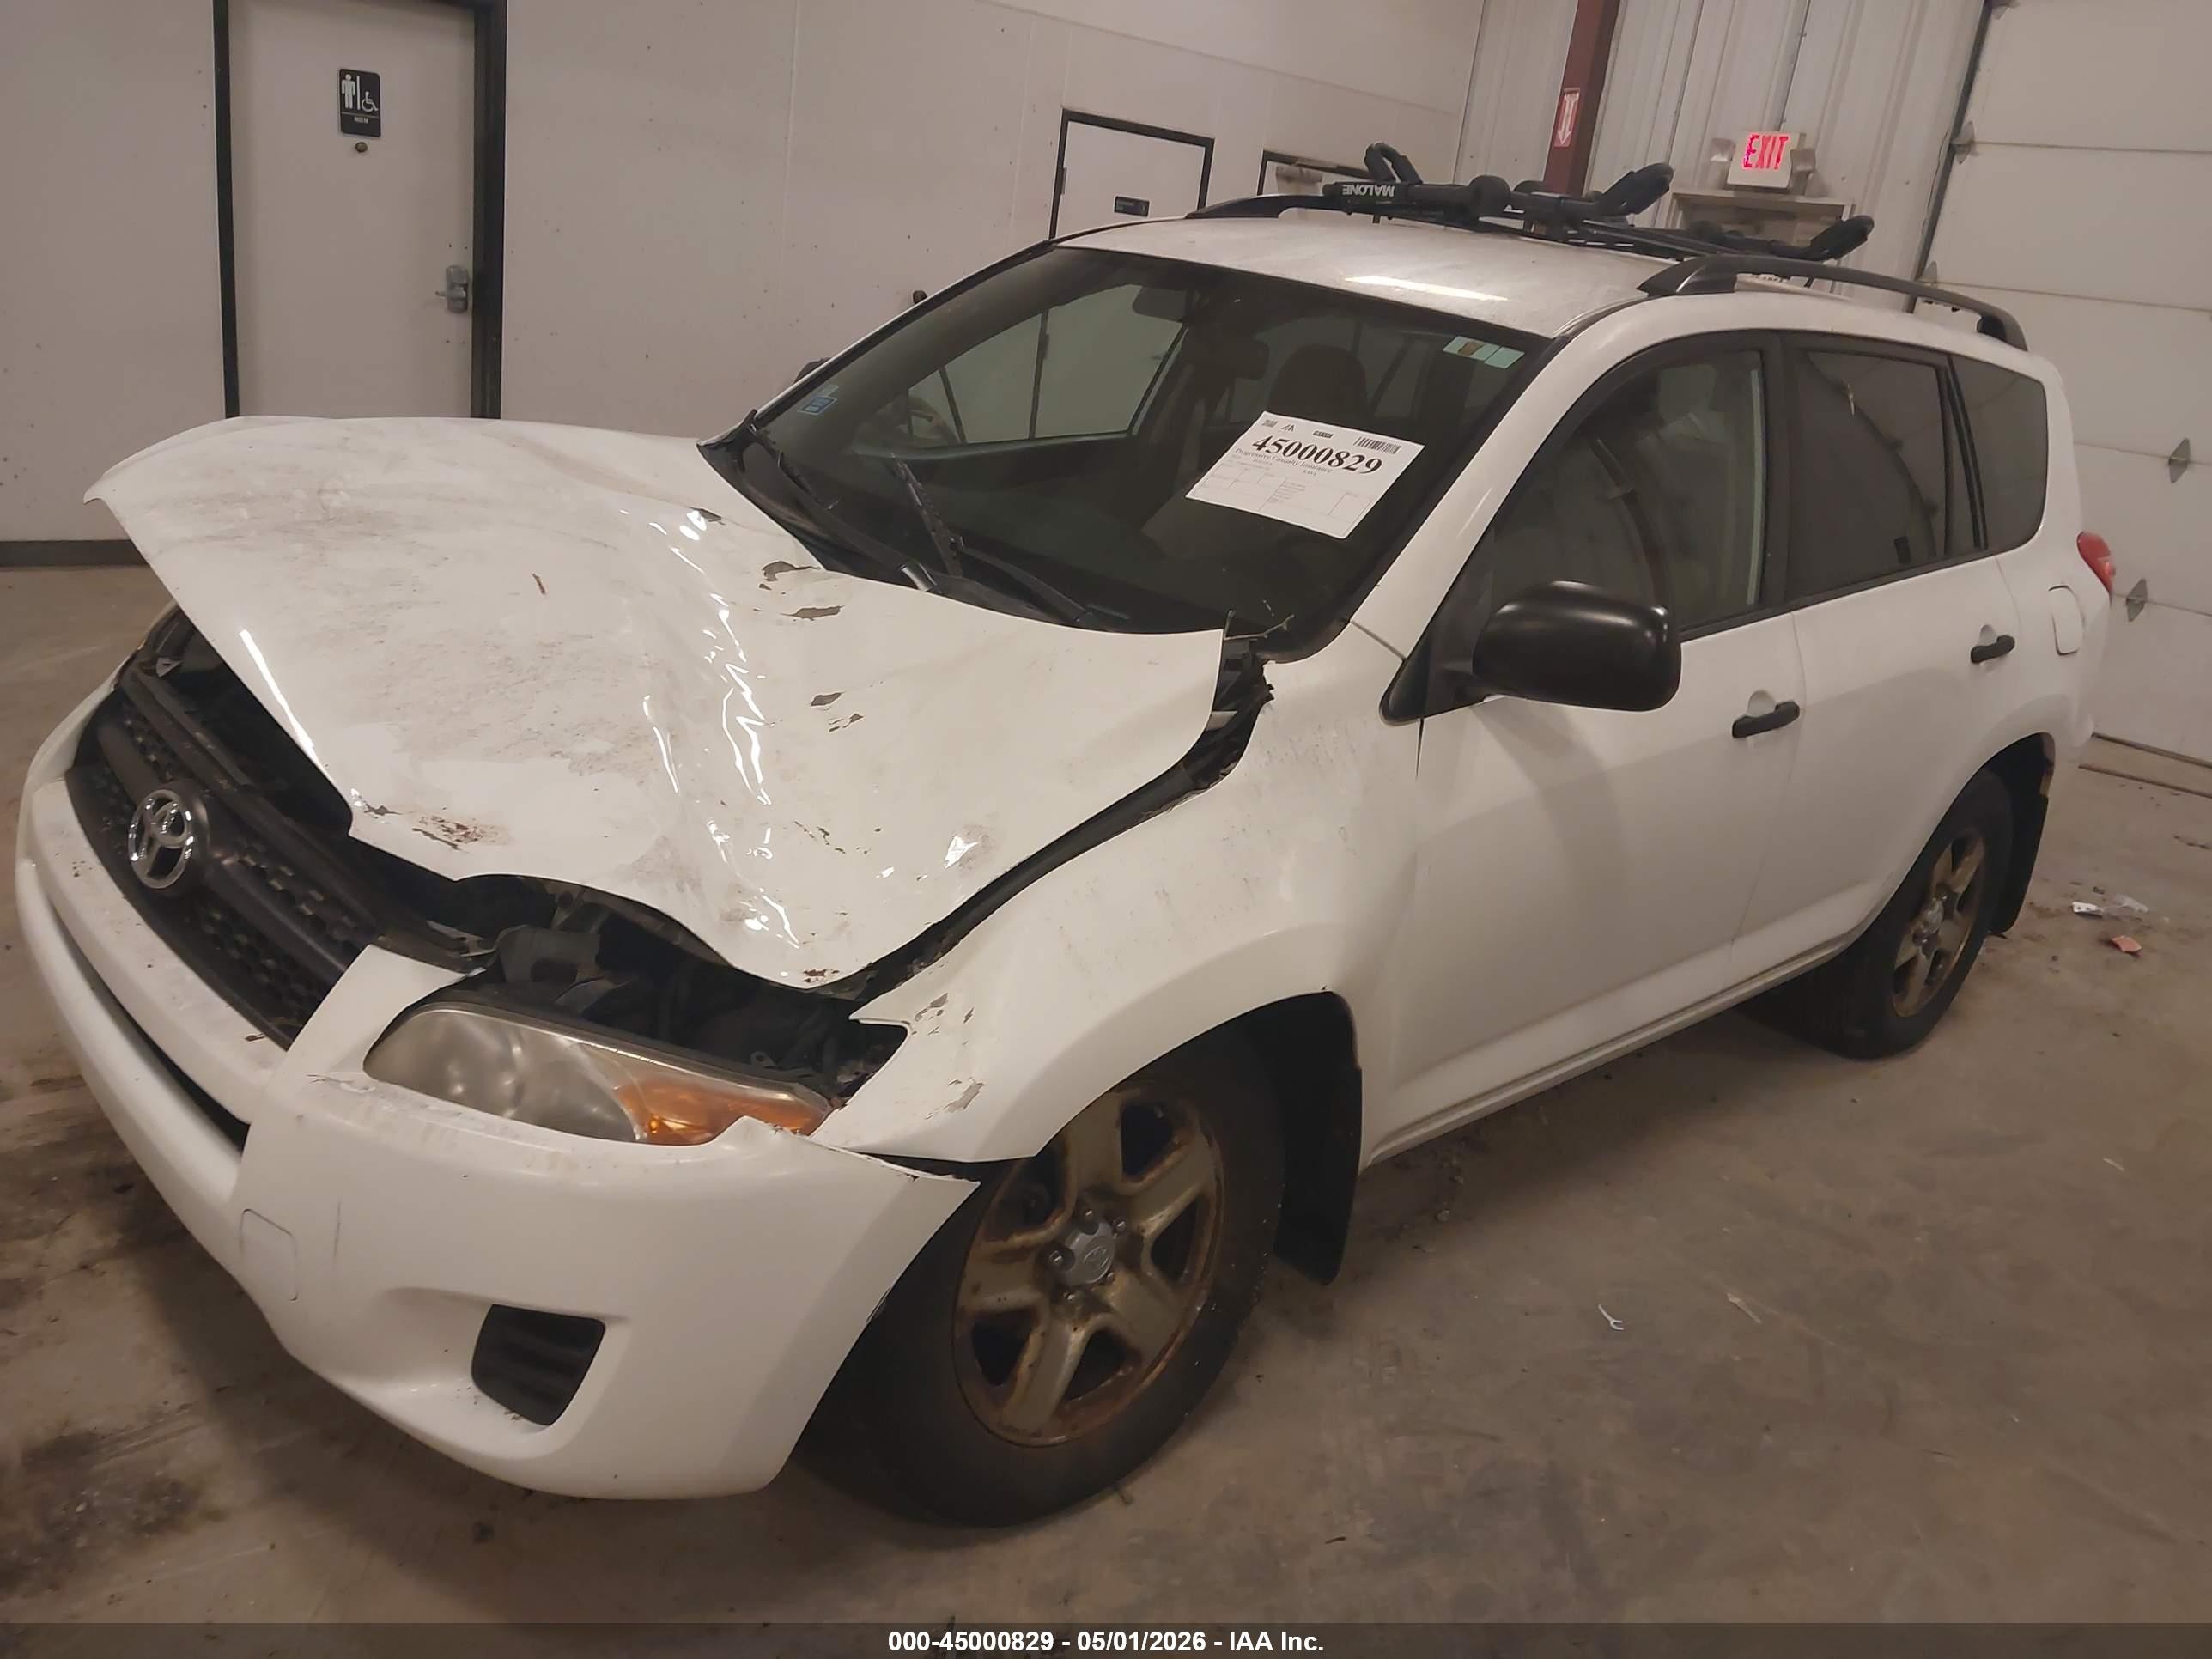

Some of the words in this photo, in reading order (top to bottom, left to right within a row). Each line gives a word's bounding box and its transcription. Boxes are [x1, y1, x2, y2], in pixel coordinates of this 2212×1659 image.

[1743, 134, 1789, 170] EXIT
[1342, 184, 1395, 198] MALONE
[1252, 435, 1382, 474] 45000829
[1271, 455, 1298, 466] Casualty
[1300, 460, 1333, 473] Insurance
